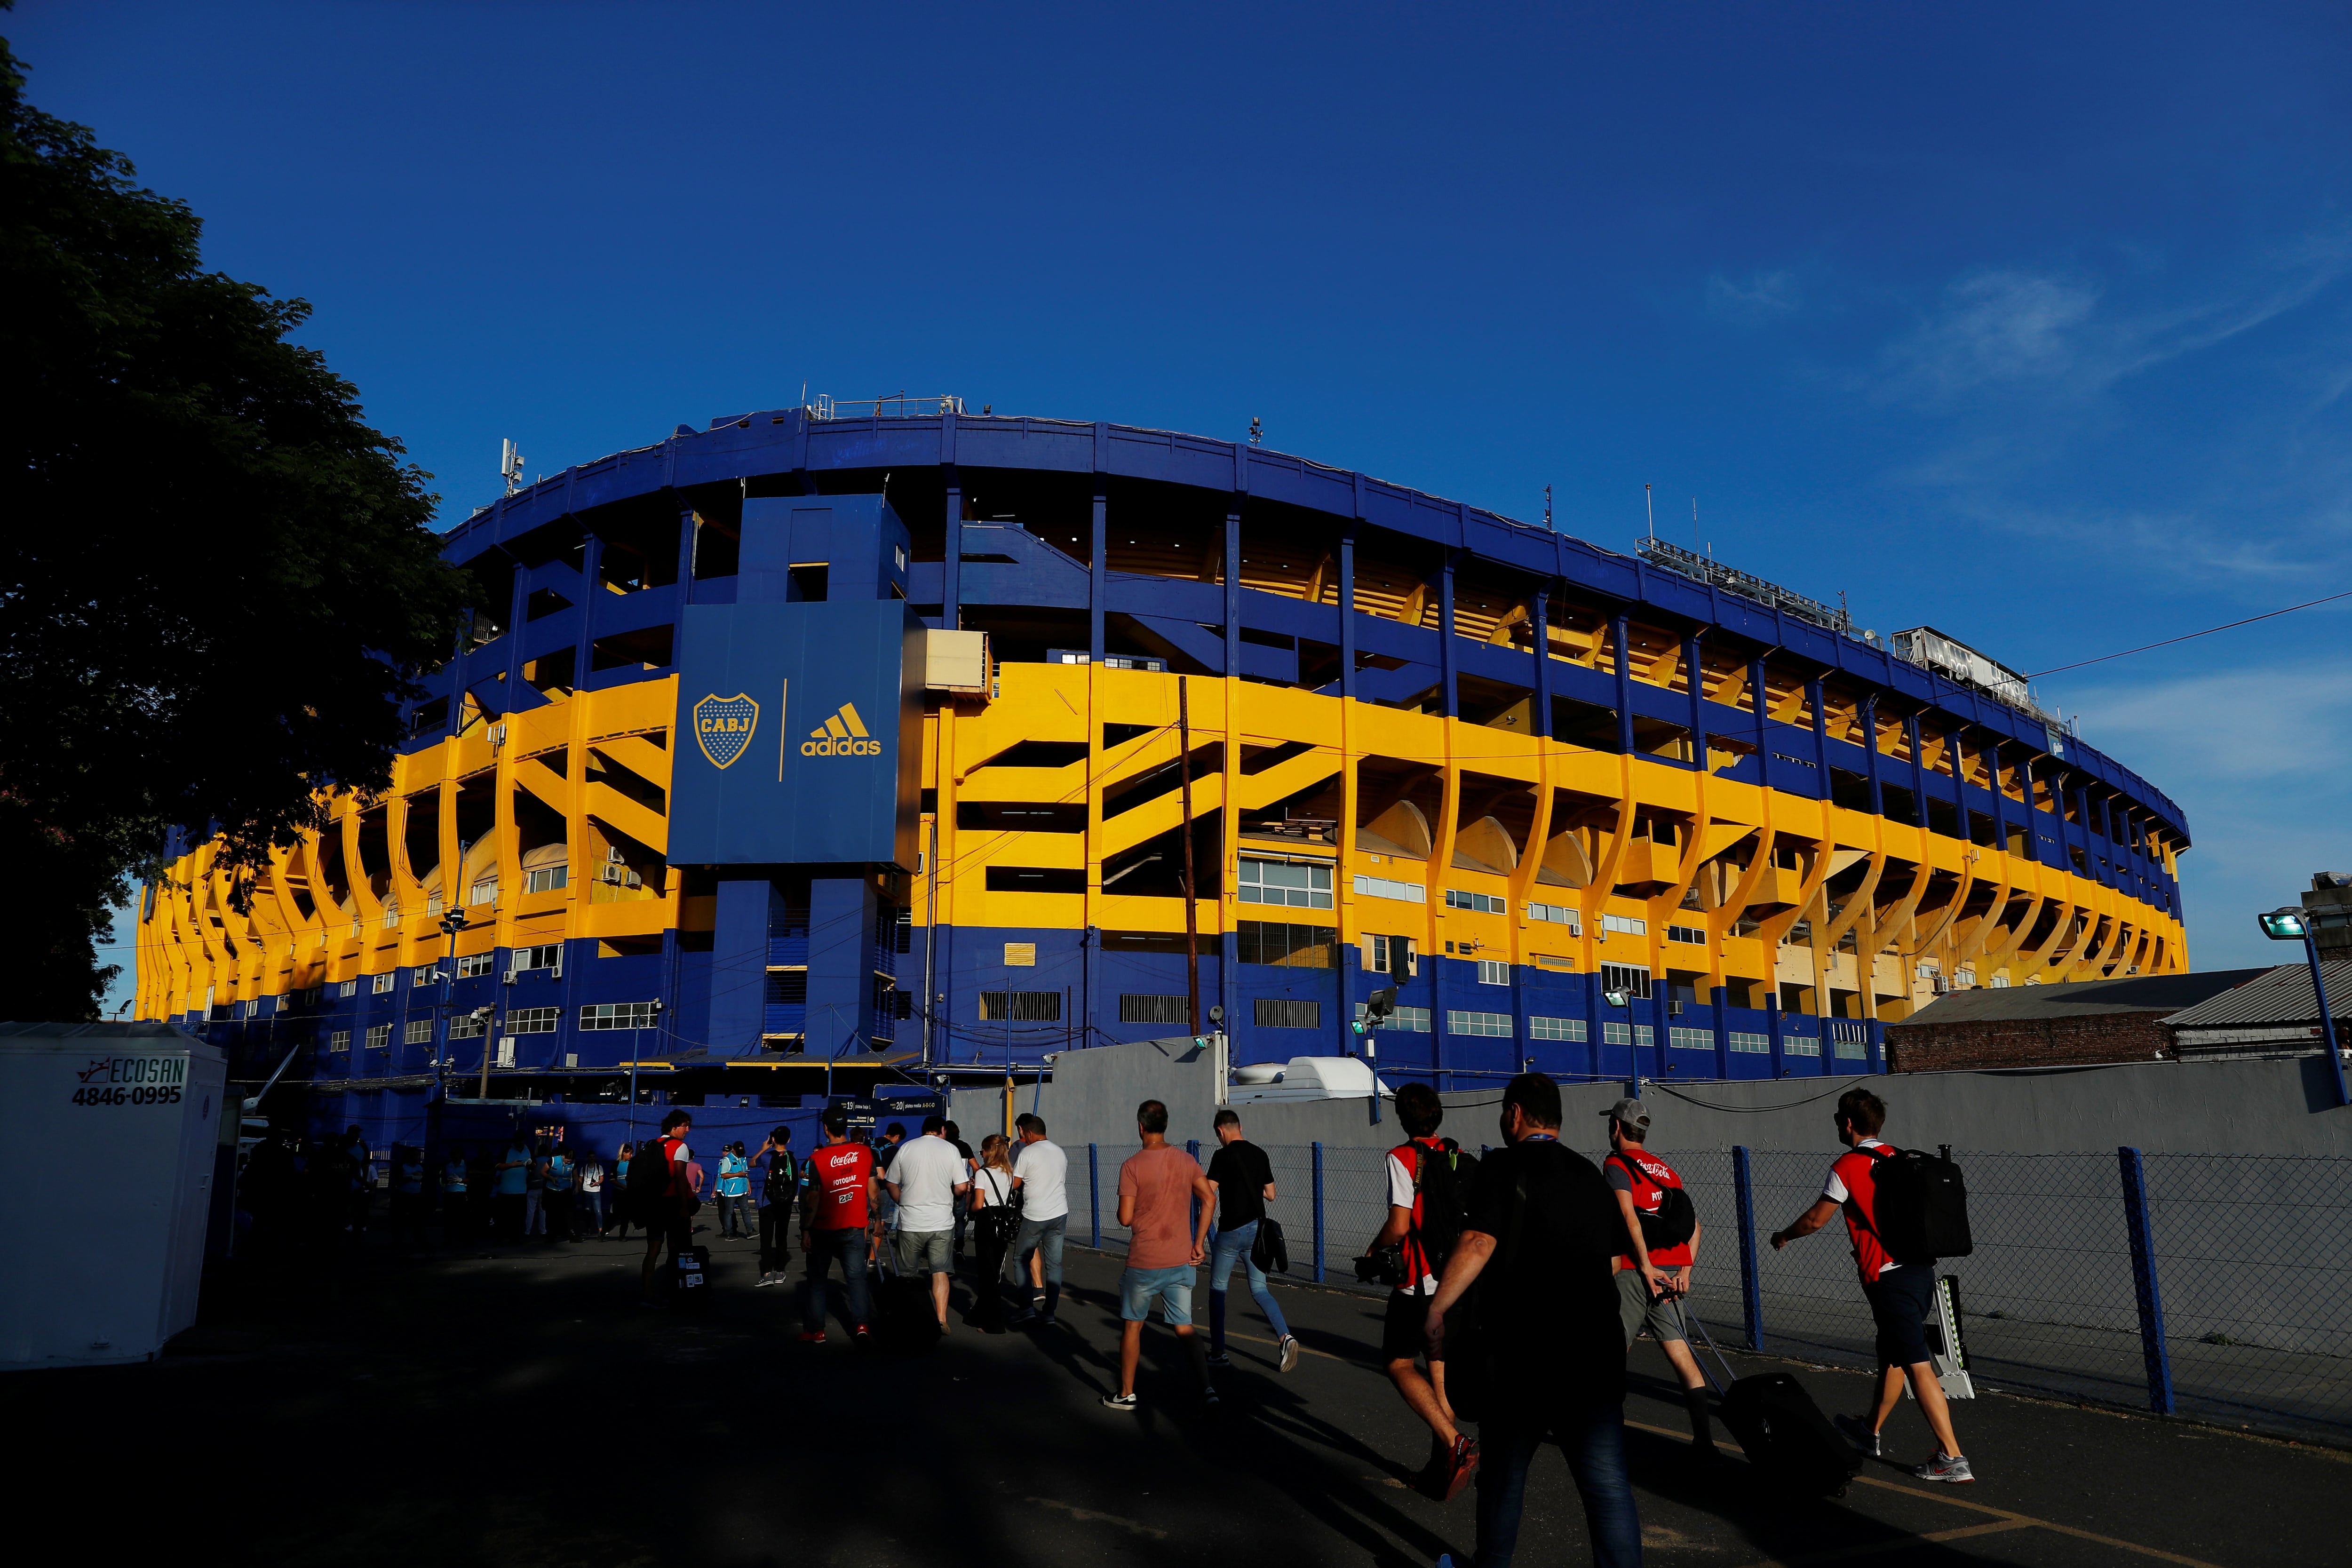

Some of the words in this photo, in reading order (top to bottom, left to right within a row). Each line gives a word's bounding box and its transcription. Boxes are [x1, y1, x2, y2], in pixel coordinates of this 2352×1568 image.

[701, 717, 750, 732] CABJ
[801, 736, 881, 756] adidas
[110, 1059, 184, 1082] ECOSAN
[72, 1086, 182, 1106] 4846-0995
[847, 1101, 853, 1110] 19
[896, 1101, 903, 1110] 20
[840, 1193, 852, 1202] 202
